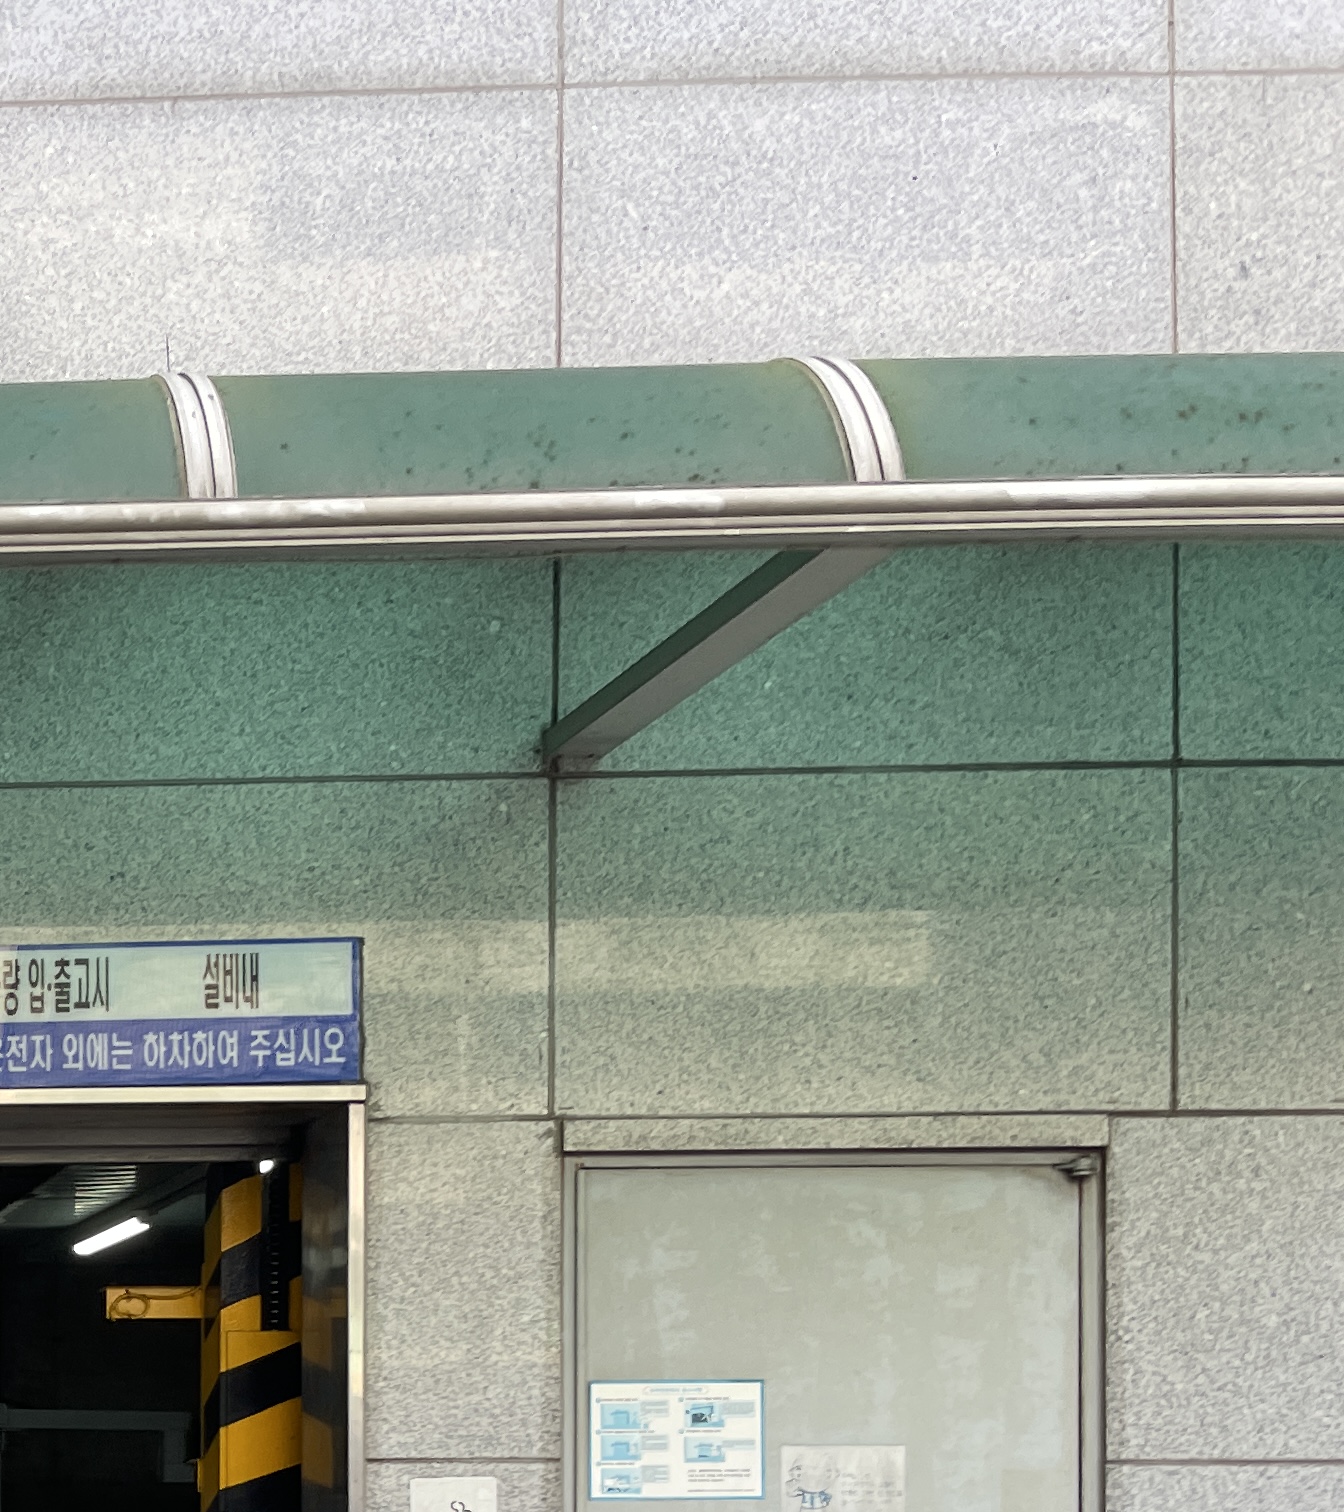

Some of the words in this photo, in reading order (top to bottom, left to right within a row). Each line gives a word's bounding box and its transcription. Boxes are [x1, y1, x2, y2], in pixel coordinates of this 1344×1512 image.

[203, 953, 259, 1009] 설비내
[62, 1032, 133, 1071] 외에는
[143, 1029, 238, 1069] 하차하여
[249, 1027, 347, 1067] 주십시오
